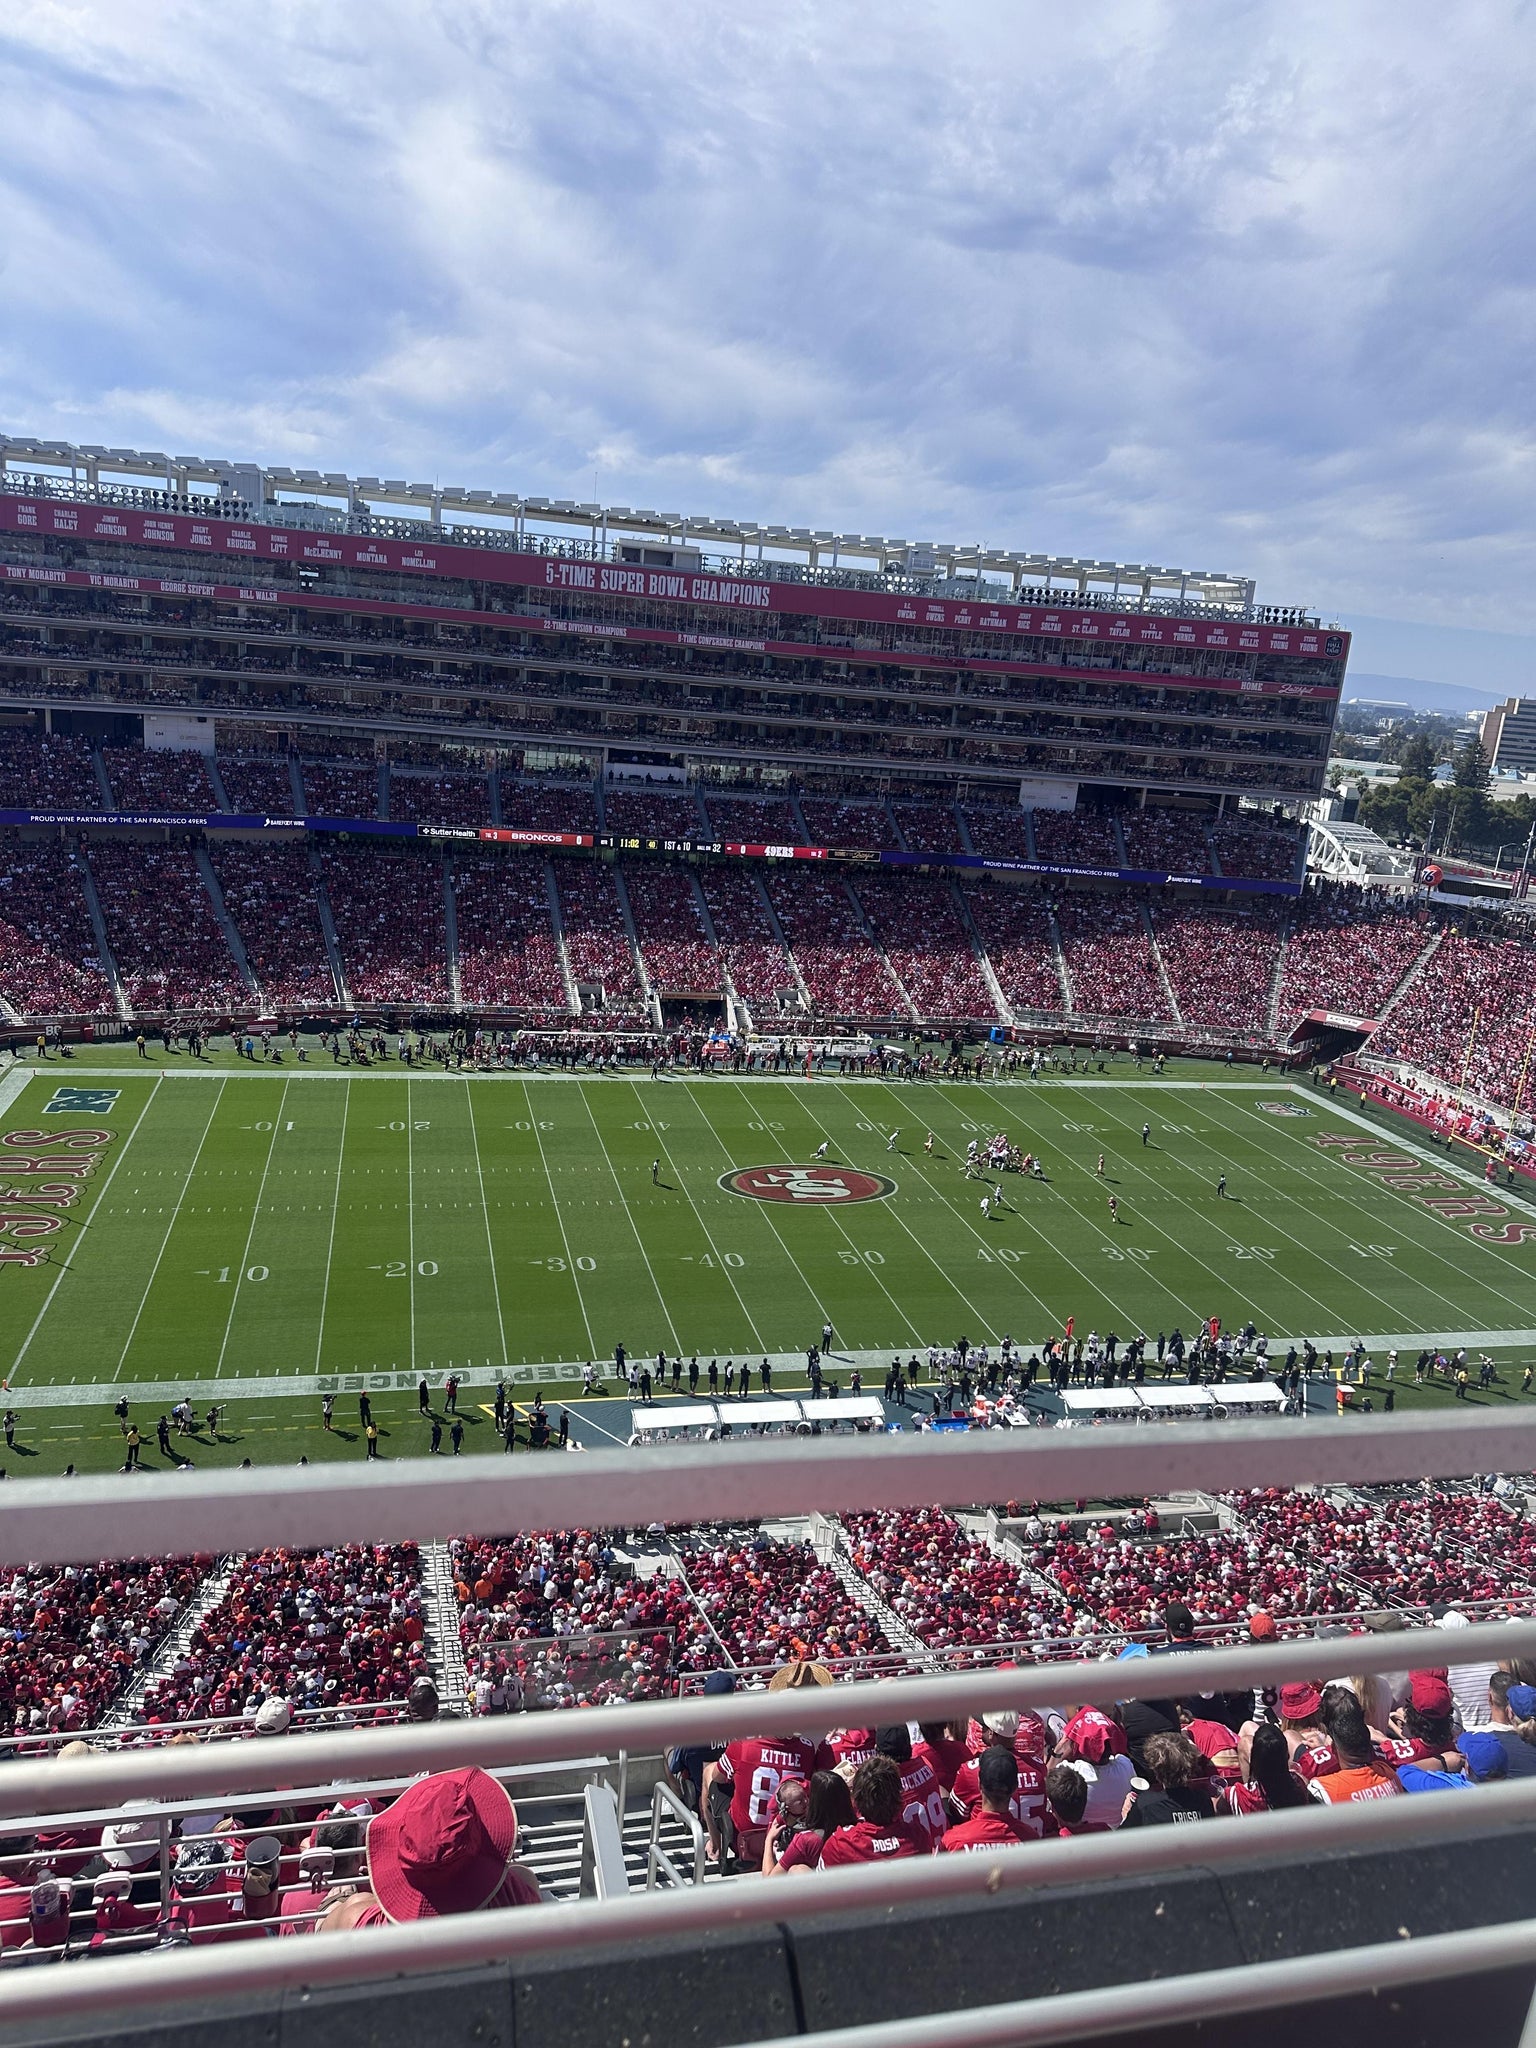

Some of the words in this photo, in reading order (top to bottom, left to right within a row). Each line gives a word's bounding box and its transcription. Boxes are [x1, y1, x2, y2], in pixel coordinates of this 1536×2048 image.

[18, 504, 36, 514] FRANK
[54, 509, 78, 519] CHARLES
[17, 514, 37, 526] GORE
[54, 518, 78, 531] HALEY
[102, 515, 119, 524] JIMMY
[143, 520, 157, 528] JOHN
[94, 523, 127, 536] JOHNSON
[142, 529, 175, 541] JOHNSON
[192, 525, 209, 534] BRENT
[190, 534, 212, 546] JONES
[226, 537, 257, 550] KRUEGER
[270, 542, 288, 554] LOTT
[356, 552, 388, 565] MONTANA
[401, 557, 436, 569] NOMELLINI
[6, 566, 27, 578] TONY
[28, 569, 66, 582] MORABITO
[89, 575, 102, 585] VIC
[103, 576, 139, 589] MORABITO
[545, 562, 595, 588] 5-TIME
[600, 570, 645, 594] SUPER
[648, 574, 688, 598] BOWL
[692, 579, 771, 607] CHAMPIONS
[160, 581, 186, 593] GEORGE
[187, 584, 215, 596] SEIFERT
[240, 589, 254, 599] BILL
[255, 590, 278, 602] WALSH
[897, 609, 917, 620] OWENS
[925, 612, 945, 622] OWENS
[954, 614, 972, 625] PERRY
[979, 617, 1008, 628] RATHMAN
[1017, 620, 1031, 630] RICE
[568, 622, 593, 634] DIVISION
[593, 625, 627, 637] CHAMPIONS
[1081, 625, 1099, 635] CLAIR
[1109, 627, 1130, 637] TAYLOR
[1141, 630, 1163, 640] TITTLE
[698, 635, 734, 648] CONFERENCE
[734, 639, 766, 651] CHAMPIONS
[1173, 632, 1196, 642] TURNER
[1206, 634, 1229, 645] WILCOX
[1239, 637, 1259, 648] WILLIS
[1270, 640, 1289, 650] YOUNG
[1300, 642, 1319, 652] YOUNG
[1240, 681, 1264, 692] HOME
[1278, 684, 1314, 696] Faithful
[430, 828, 452, 836] Sutter
[453, 829, 476, 838] Health
[493, 832, 498, 840] 3
[511, 832, 563, 842] BRONCOS
[576, 835, 582, 845] 0
[609, 838, 614, 847] 1
[620, 838, 640, 849] 11:02
[648, 841, 656, 849] 40
[664, 841, 676, 850] 1ST
[682, 841, 691, 851] 10
[712, 843, 721, 853] 32
[740, 845, 746, 854] 0
[764, 846, 794, 858] 49ERS
[1071, 868, 1103, 876] FRANCISCO
[1422, 870, 1434, 882] 76
[162, 1017, 221, 1033] Faithful
[1415, 1150, 1474, 1178] TAKES
[1305, 1130, 1536, 1245] 49ERS
[976, 1248, 1021, 1263] 40
[1101, 1247, 1150, 1261] 30
[1226, 1245, 1275, 1260] 20
[1347, 1243, 1394, 1258] 10
[699, 1252, 745, 1268] 40
[837, 1250, 885, 1265] 50
[385, 1260, 439, 1277] 20
[547, 1256, 597, 1272] 30
[213, 1265, 270, 1282] 10
[317, 1370, 471, 1391] CANCER
[1391, 1738, 1415, 1759] 23
[760, 1748, 801, 1767] KITTLE
[1309, 1748, 1331, 1765] 13
[899, 1765, 934, 1792] UCKNER
[748, 1766, 805, 1825] 8
[1009, 1794, 1046, 1838] 5
[871, 1836, 900, 1853] BOSA
